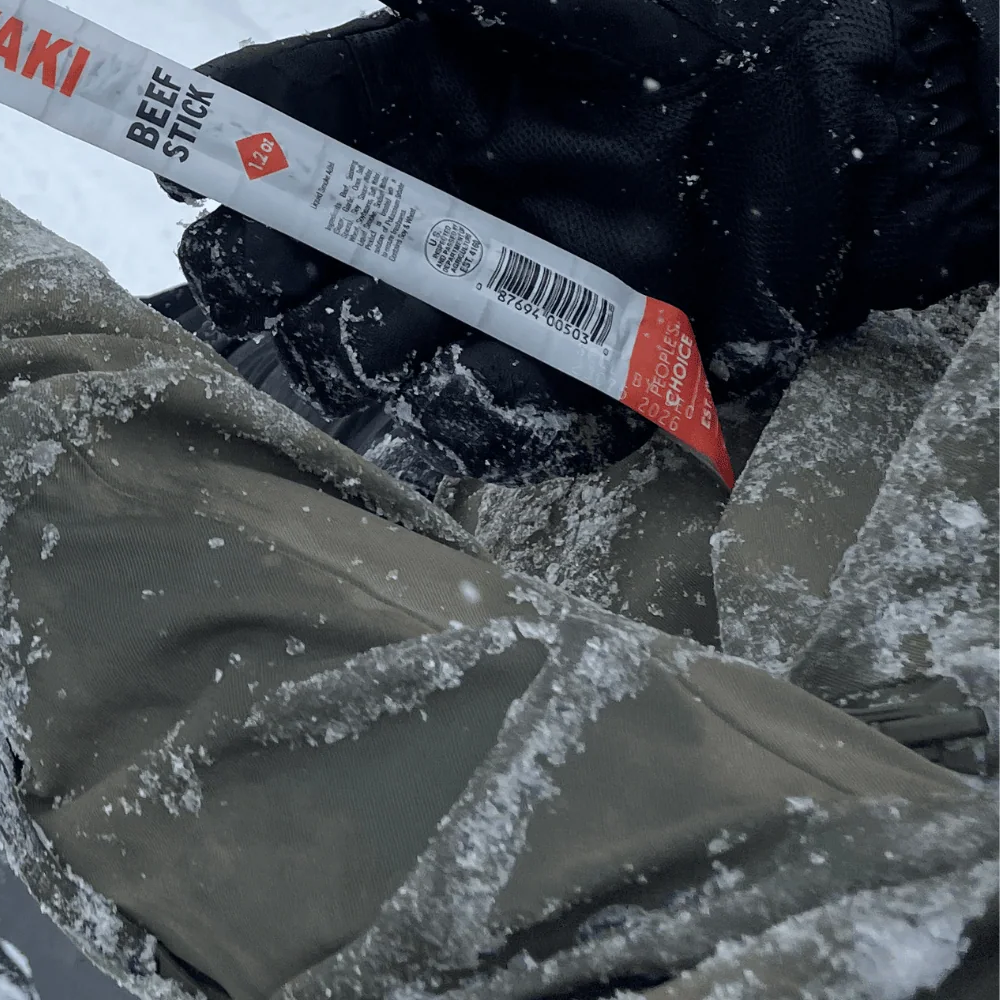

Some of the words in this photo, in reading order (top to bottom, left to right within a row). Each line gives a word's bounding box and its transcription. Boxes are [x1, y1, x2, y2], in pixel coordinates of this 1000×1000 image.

[126, 66, 182, 150] BEEF
[163, 83, 215, 163] STICK
[248, 151, 268, 171] 1.2
[260, 138, 275, 153] oz
[476, 282, 482, 290] 0
[497, 290, 540, 319] 87694
[546, 315, 589, 345] 00503
[665, 334, 693, 408] CHOICE
[637, 397, 679, 432] 2026
